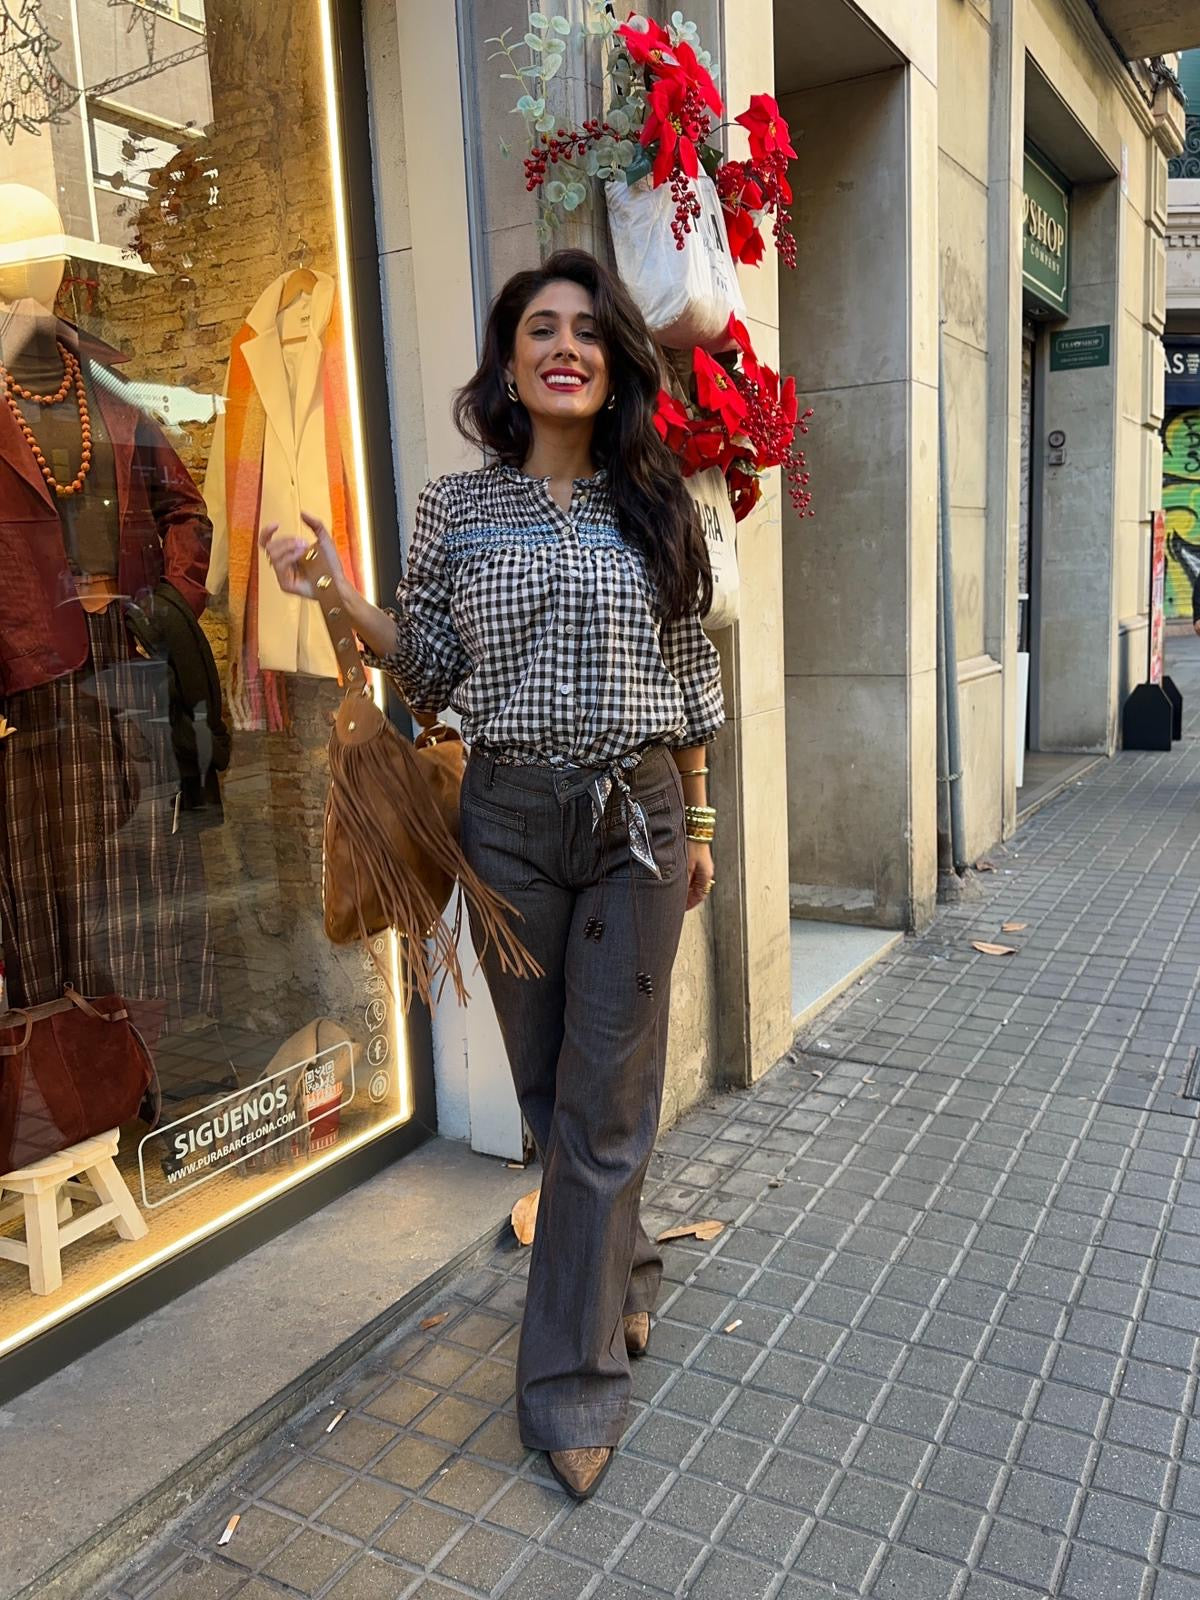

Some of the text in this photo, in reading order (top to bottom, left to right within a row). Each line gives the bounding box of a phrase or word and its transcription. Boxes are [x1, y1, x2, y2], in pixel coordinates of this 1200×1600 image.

[1029, 199, 1064, 257] SHOP
[695, 499, 723, 542] URA
[167, 1110, 297, 1184] WWW.PURABARCELONA.COM
[174, 1085, 288, 1160] SIGUENOS
